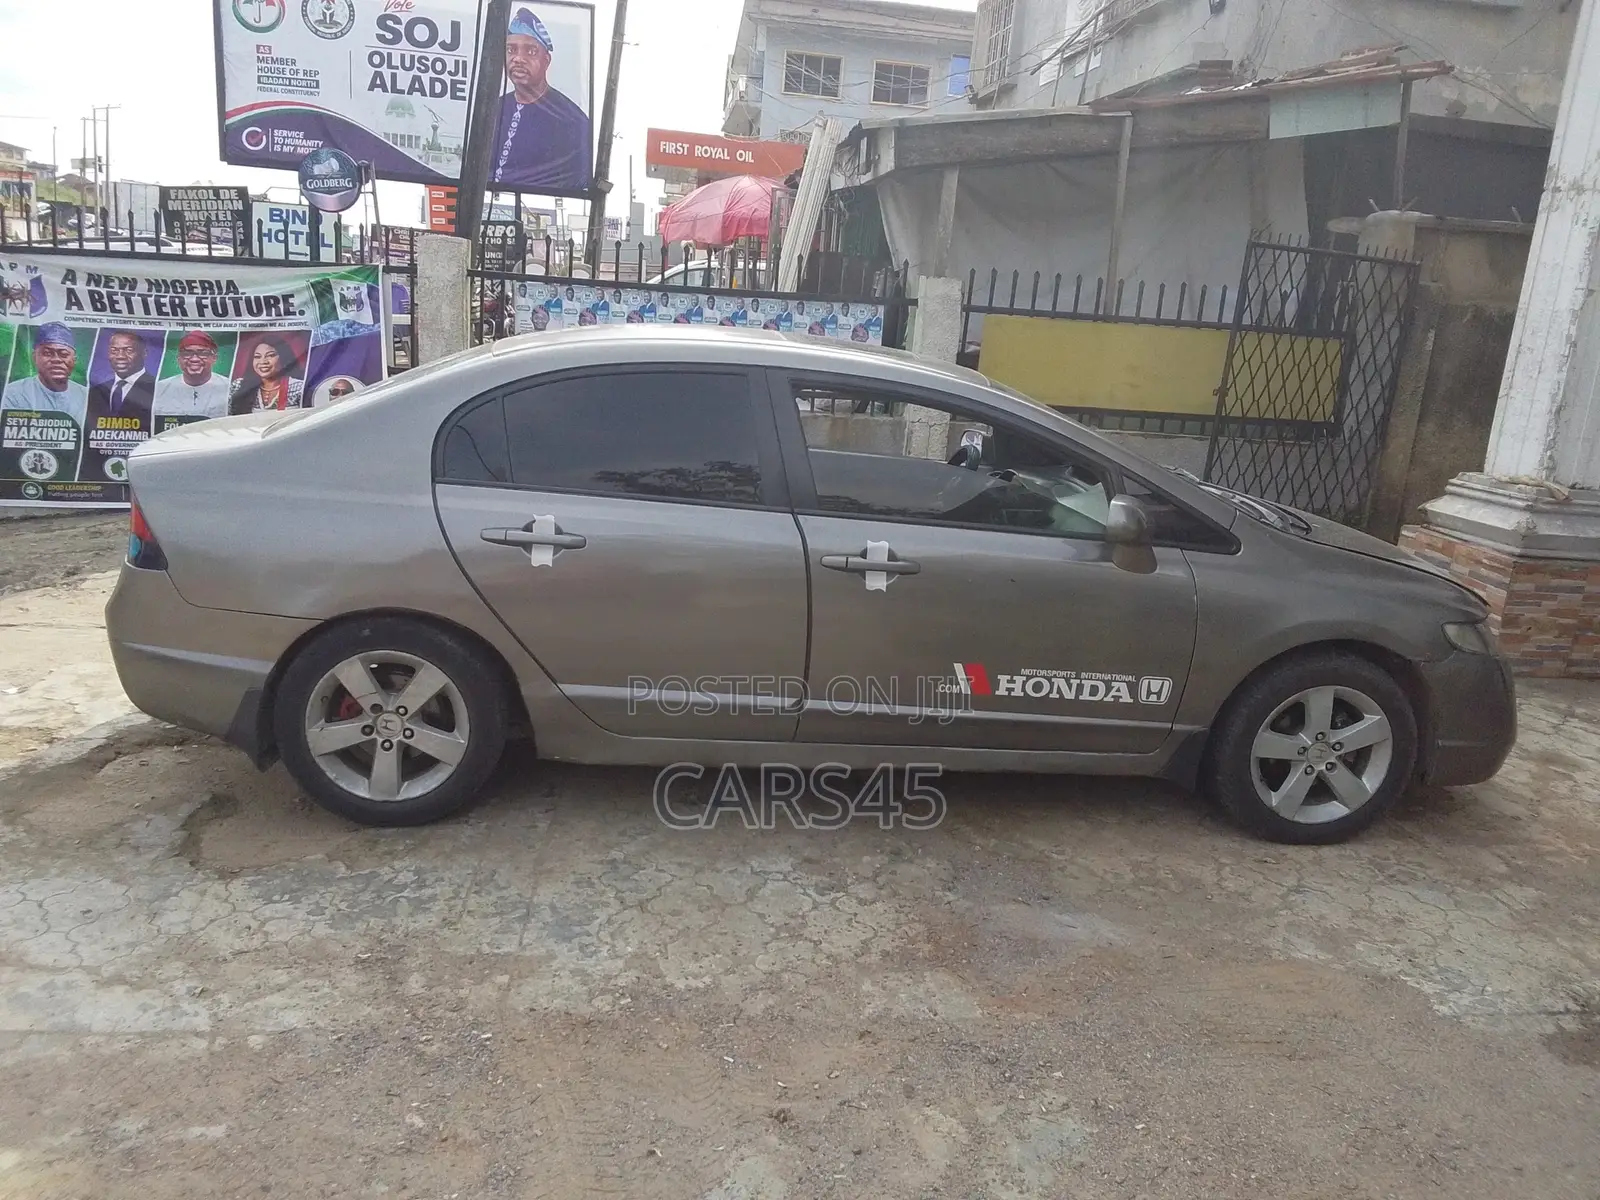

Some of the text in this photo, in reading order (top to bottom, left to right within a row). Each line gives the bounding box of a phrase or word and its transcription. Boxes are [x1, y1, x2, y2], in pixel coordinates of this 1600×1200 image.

[384, 0, 416, 12] Vote
[375, 13, 461, 52] SOJ
[259, 46, 270, 54] AS
[257, 56, 297, 67] MEMBER
[367, 50, 468, 78] OLUSOJI
[257, 66, 320, 78] HOUSE OF REP
[260, 76, 316, 88] IBADAN NORTH
[367, 70, 467, 101] ALADE
[281, 88, 320, 97] CONSTITUENCY
[273, 129, 304, 138] SERVICE
[283, 145, 294, 153] MY
[284, 138, 324, 148] HUMANITY
[660, 141, 755, 163] FIRST ROYAL OIL
[306, 178, 353, 189] GOLDBERG
[169, 189, 238, 200] FAKOL DE
[168, 200, 244, 211] MERIDIAN
[261, 228, 333, 248] HOTL
[60, 268, 247, 296] A NEW NIGERIA.
[65, 287, 306, 318] A BETTER FUTURE.
[6, 417, 72, 427] SEYI ABIODUN
[97, 417, 140, 430] BIMBO
[4, 426, 77, 441] MAKINDE
[1021, 668, 1137, 683] MOTORSPORTS INTERNATIONAL
[995, 674, 1134, 703] HONDA
